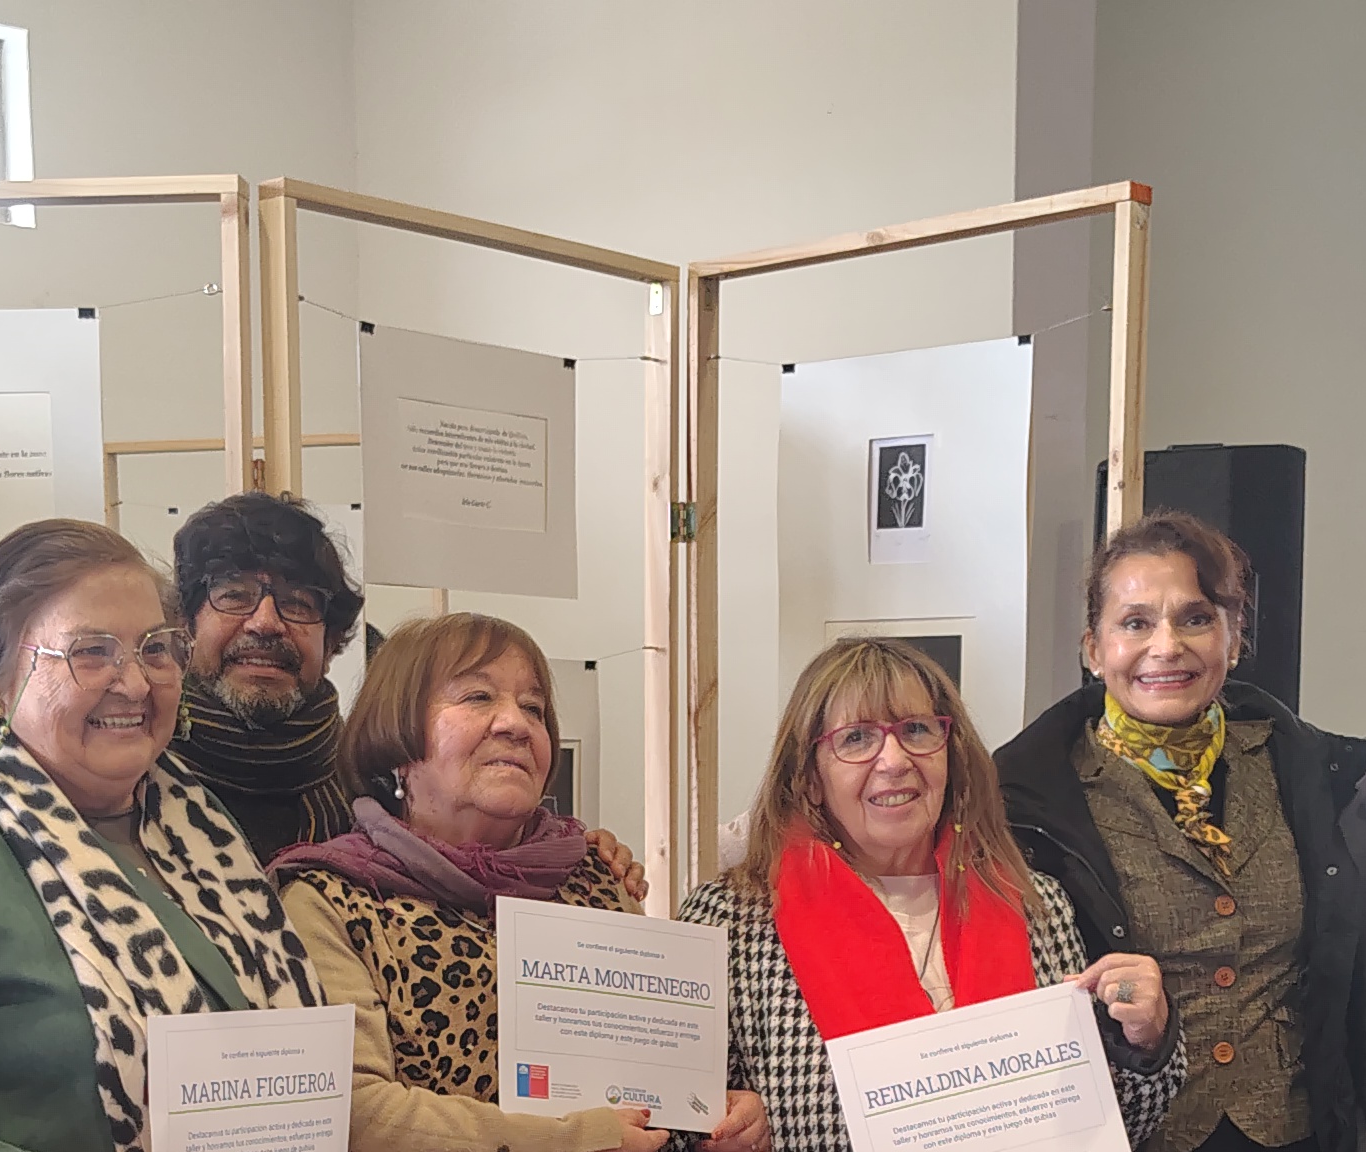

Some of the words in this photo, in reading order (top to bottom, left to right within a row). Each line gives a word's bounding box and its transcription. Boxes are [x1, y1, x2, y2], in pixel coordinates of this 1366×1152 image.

[522, 959, 591, 984] MARTA
[595, 968, 710, 1001] MONTENEGRO
[181, 1078, 251, 1105] MARINA
[256, 1071, 336, 1098] FIGUEROA
[865, 1065, 987, 1109] REINALDINA
[988, 1041, 1082, 1079] MORALES
[623, 1093, 661, 1104] CULTURA
[893, 1118, 937, 1134] Destacamos
[946, 1105, 991, 1123] participación
[992, 1100, 1012, 1110] activa
[1019, 1091, 1050, 1103] dedicada
[1061, 1084, 1075, 1093] este
[893, 1136, 911, 1145] taller
[918, 1126, 953, 1139] honramos
[966, 1110, 1018, 1127] conocimientos,
[1019, 1103, 1048, 1114] esfuerzo
[1055, 1094, 1080, 1106] entrega
[937, 1137, 952, 1146] este
[953, 1130, 981, 1142] diploma
[988, 1125, 1002, 1134] este
[1003, 1120, 1023, 1131] juego
